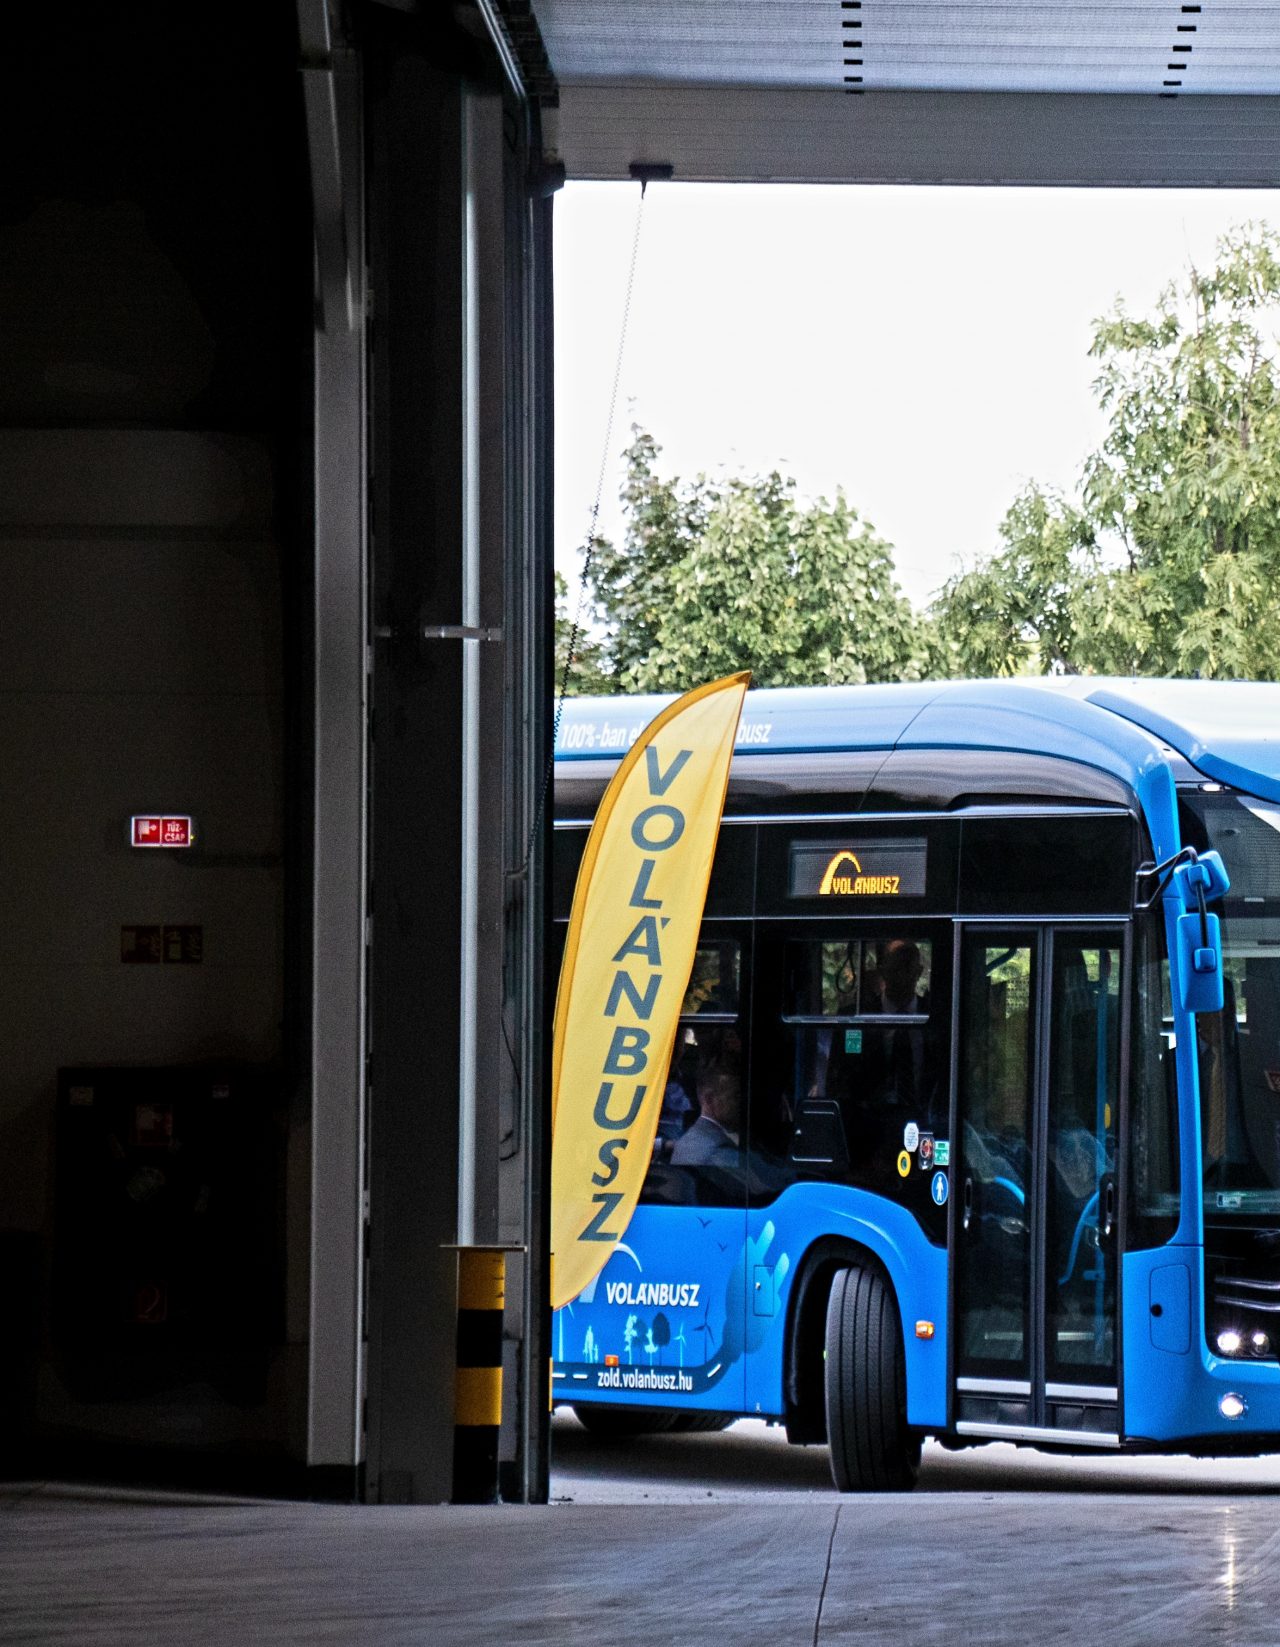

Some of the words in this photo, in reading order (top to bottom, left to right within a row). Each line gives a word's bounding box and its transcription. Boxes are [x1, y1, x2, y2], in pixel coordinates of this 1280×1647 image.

[560, 721, 627, 749] 100%-ban
[164, 833, 186, 842] CSAP
[832, 876, 900, 894] VOLÁNBUSZ
[576, 745, 694, 1242] VOLÁNBUSZ
[606, 1281, 701, 1307] VOLÁNBUSZ
[597, 1366, 693, 1391] zold.volanbusz.hu
